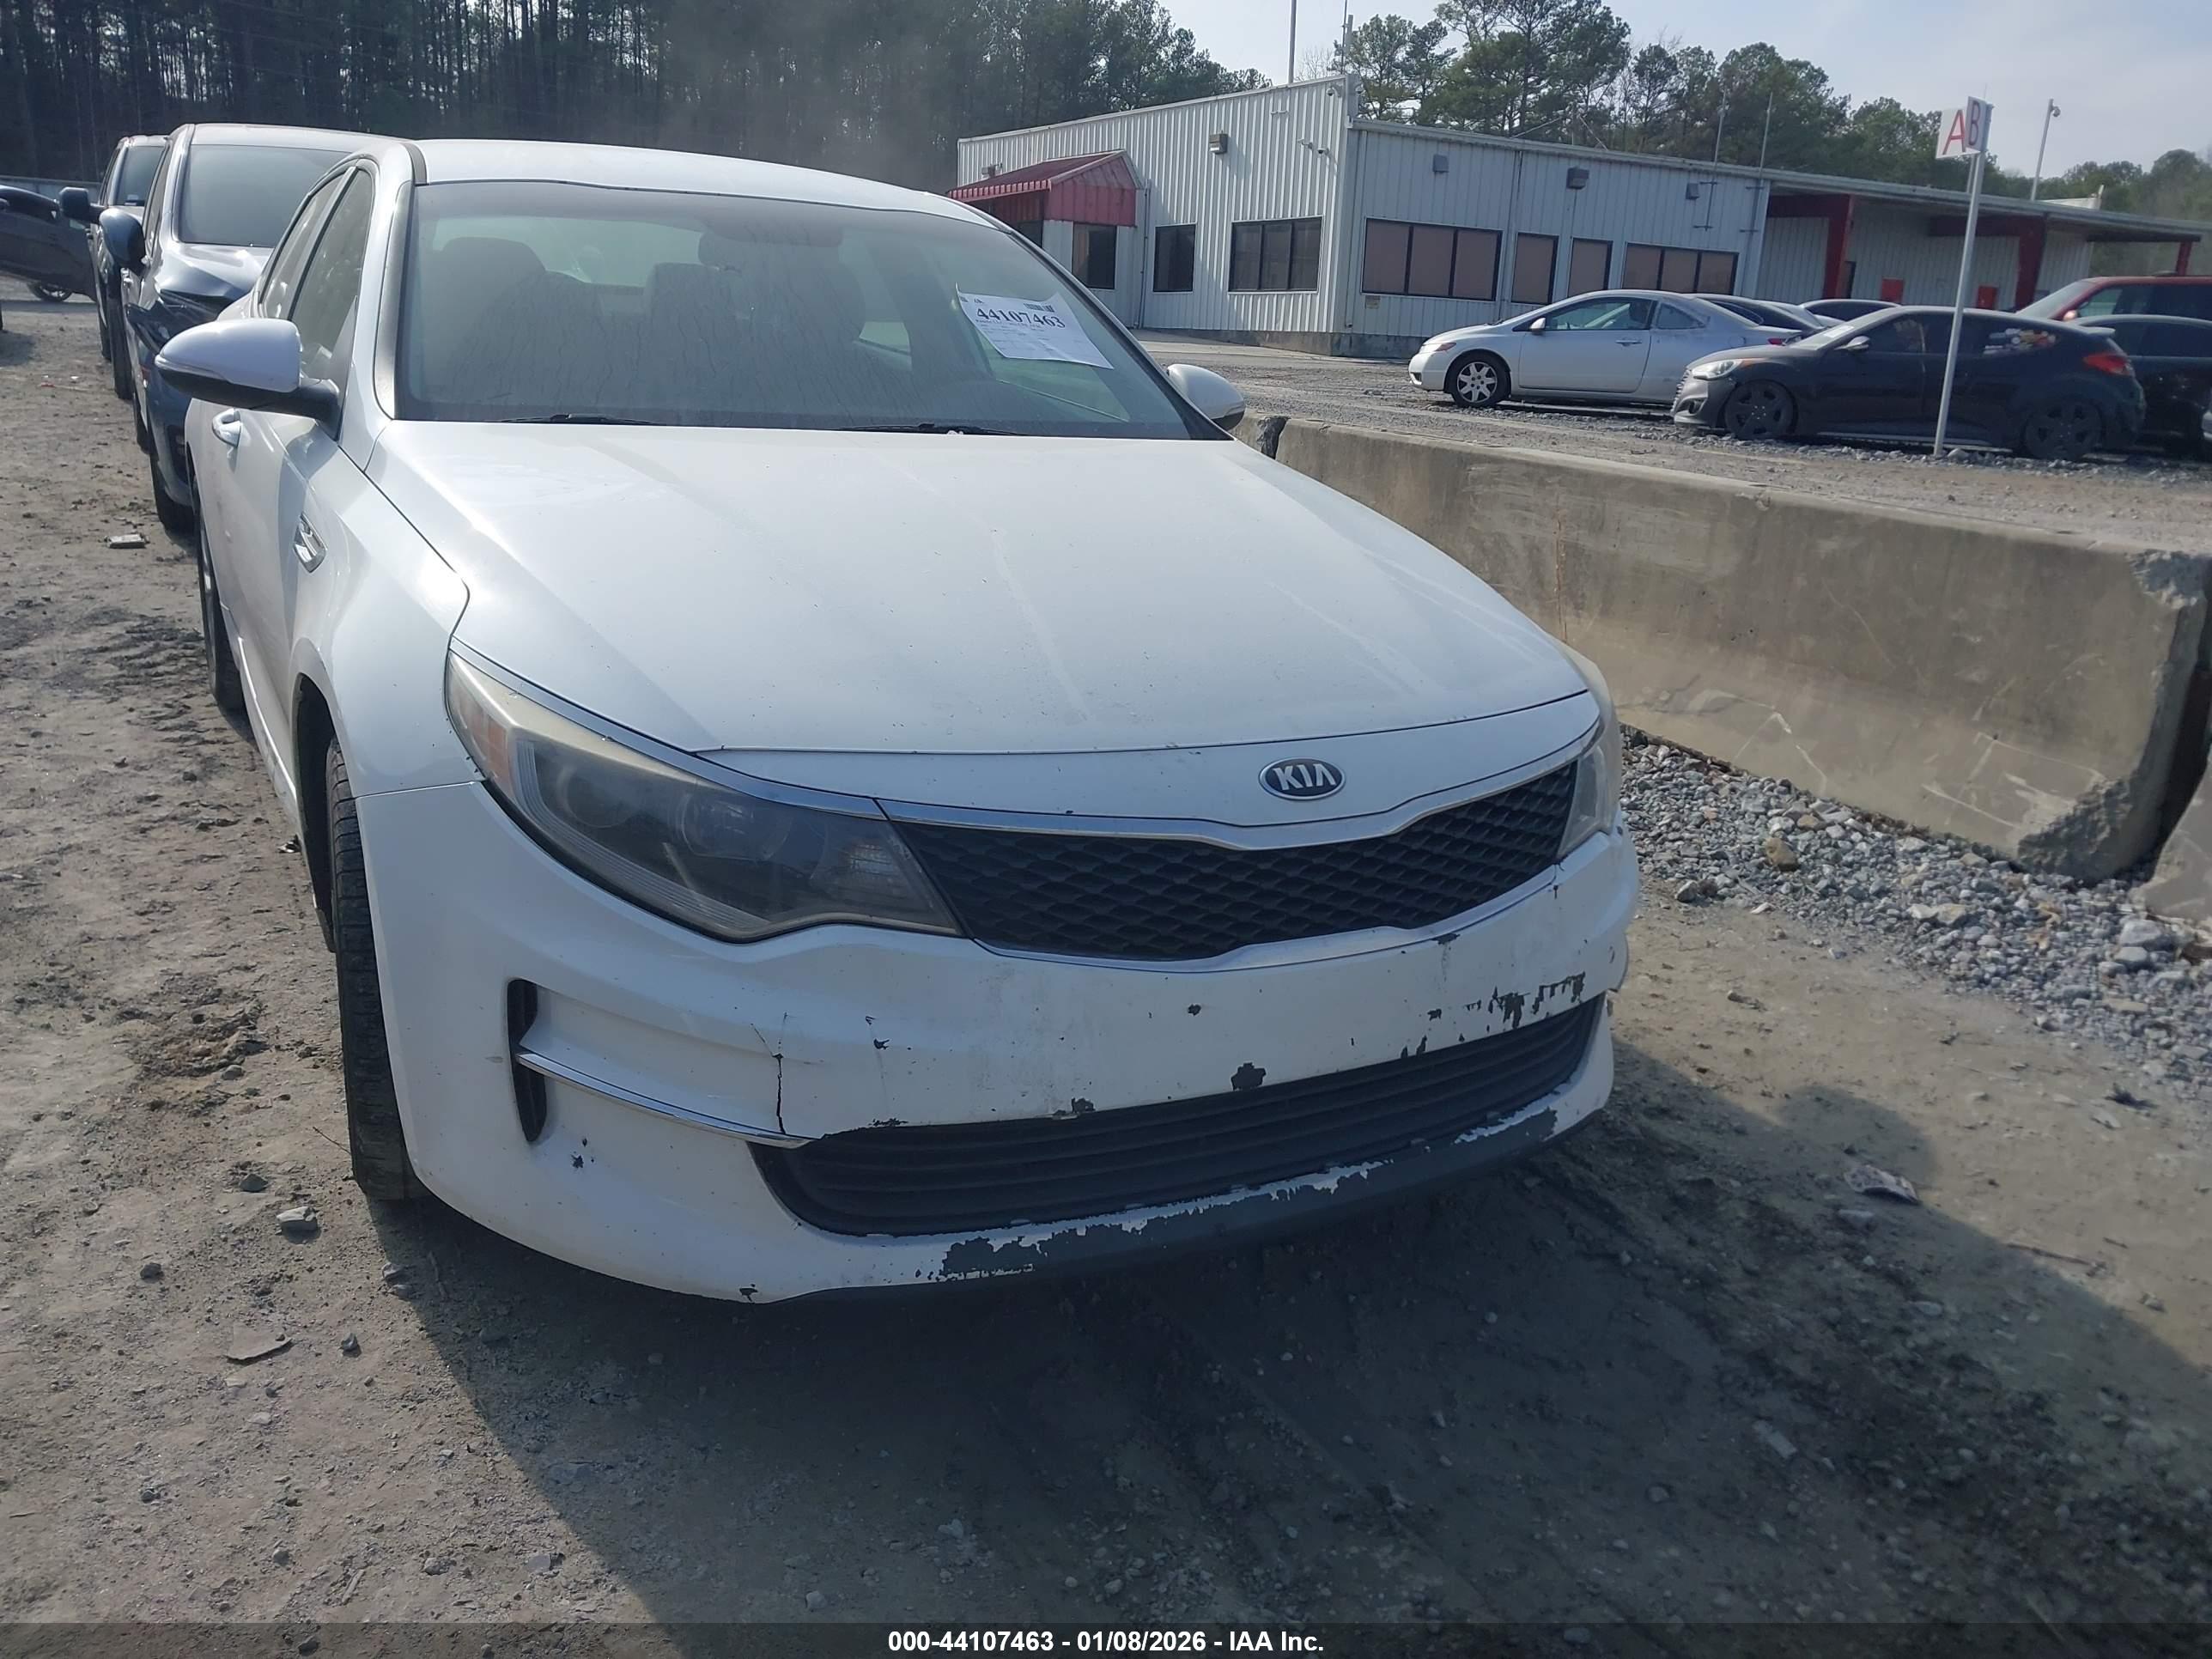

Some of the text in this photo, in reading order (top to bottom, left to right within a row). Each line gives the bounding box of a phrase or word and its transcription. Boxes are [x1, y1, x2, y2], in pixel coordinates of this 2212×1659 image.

[1942, 109, 1966, 155] A
[1969, 100, 1981, 146] B
[976, 307, 1066, 328] 44107463
[1273, 763, 1336, 790] KIA
